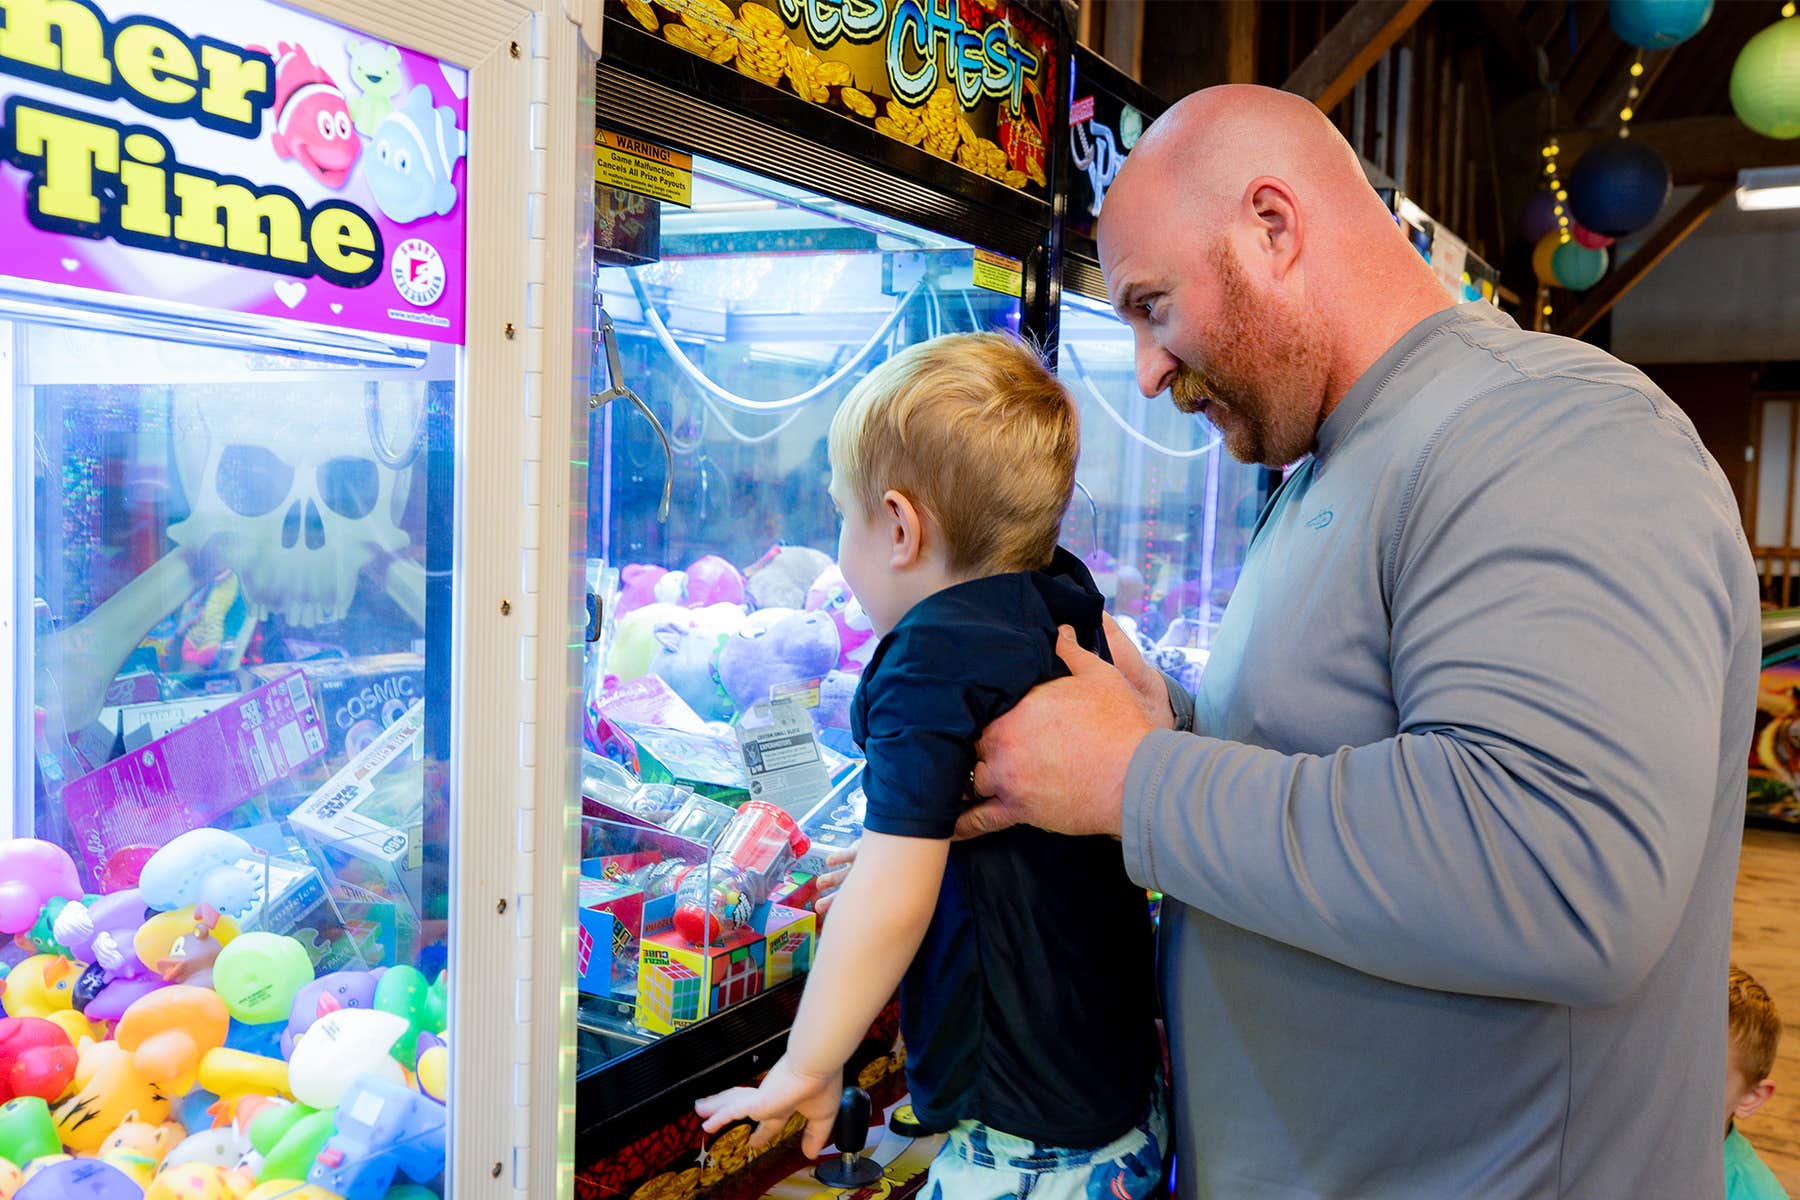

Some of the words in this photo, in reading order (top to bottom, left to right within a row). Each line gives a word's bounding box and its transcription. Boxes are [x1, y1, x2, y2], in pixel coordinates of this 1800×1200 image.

[888, 0, 1038, 115] CHEST
[611, 152, 633, 166] Game
[633, 158, 675, 178] Malfunction
[615, 135, 671, 162] WARNING!
[16, 104, 376, 275] Time
[597, 158, 627, 174] Cancels
[629, 167, 639, 177] All
[640, 170, 658, 183] Prize
[659, 175, 687, 191] Payouts
[336, 676, 413, 729] COSMIC
[642, 950, 669, 959] CUBE
